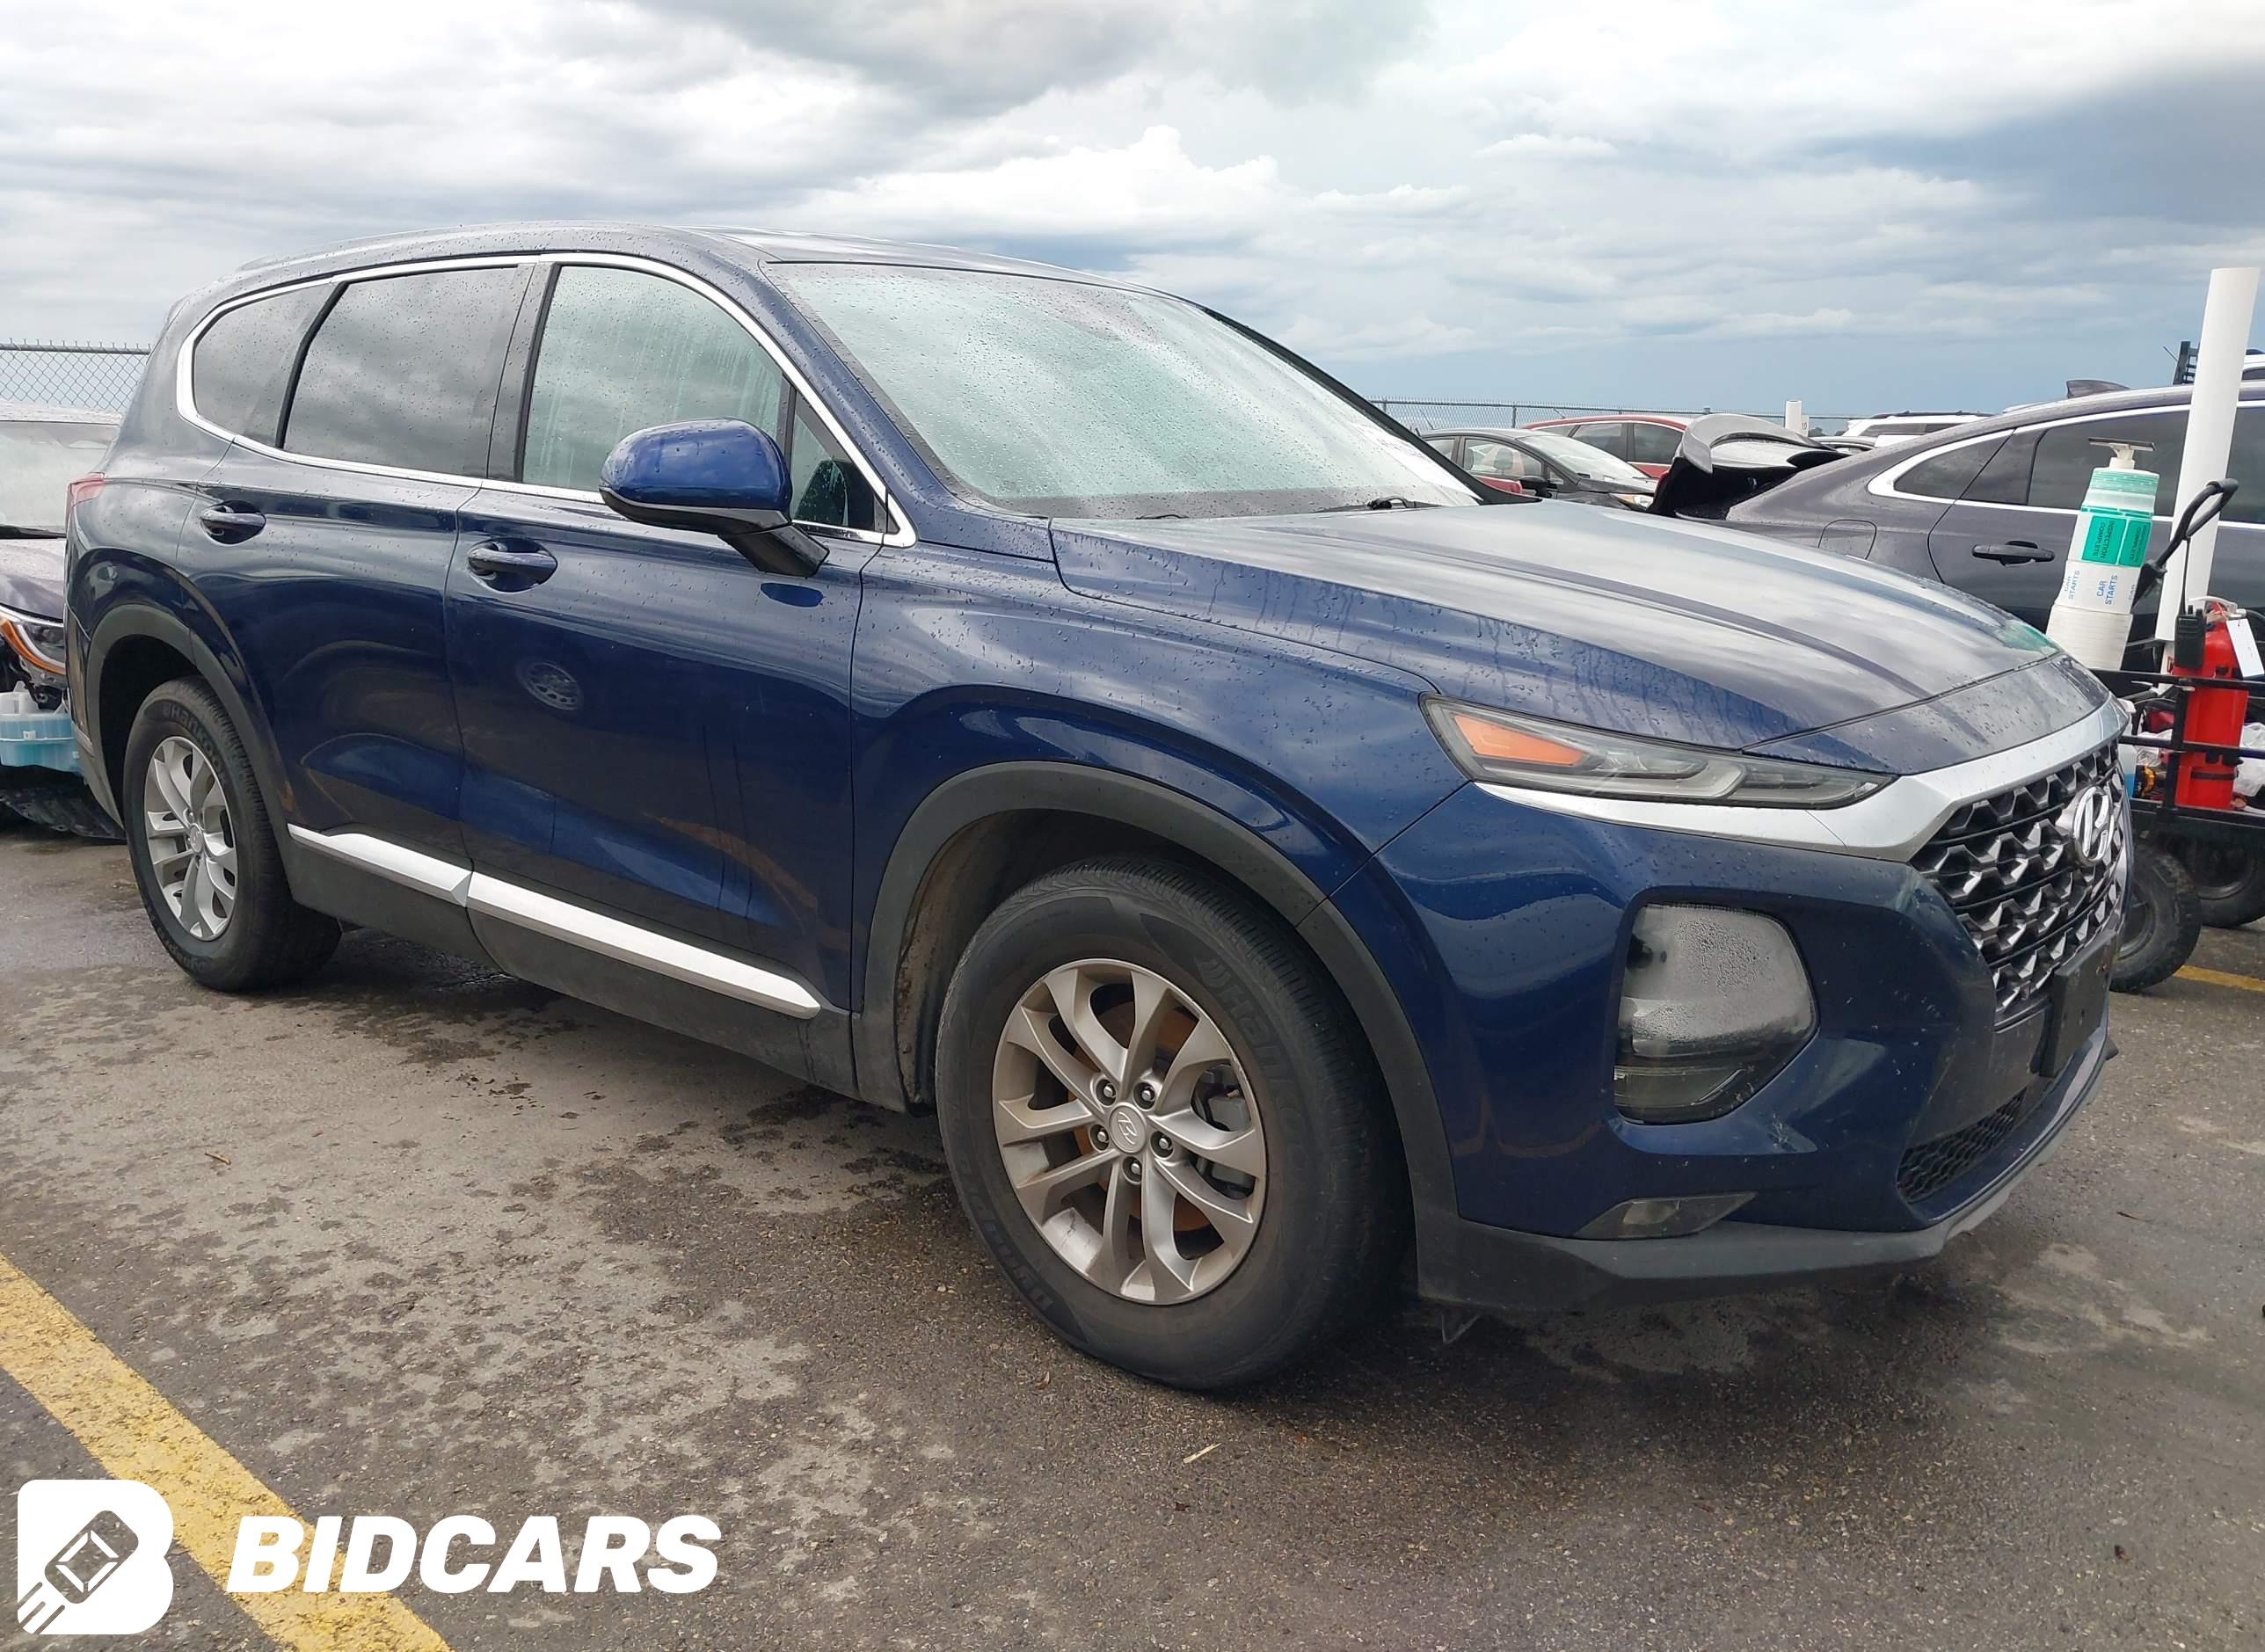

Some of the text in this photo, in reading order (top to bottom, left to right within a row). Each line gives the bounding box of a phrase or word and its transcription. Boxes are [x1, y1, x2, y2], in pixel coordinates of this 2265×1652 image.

[2093, 522, 2106, 557] COMPLETE
[2100, 520, 2116, 558] INSPECTION
[2096, 580, 2108, 597] CAR
[2105, 574, 2118, 605] STARTS
